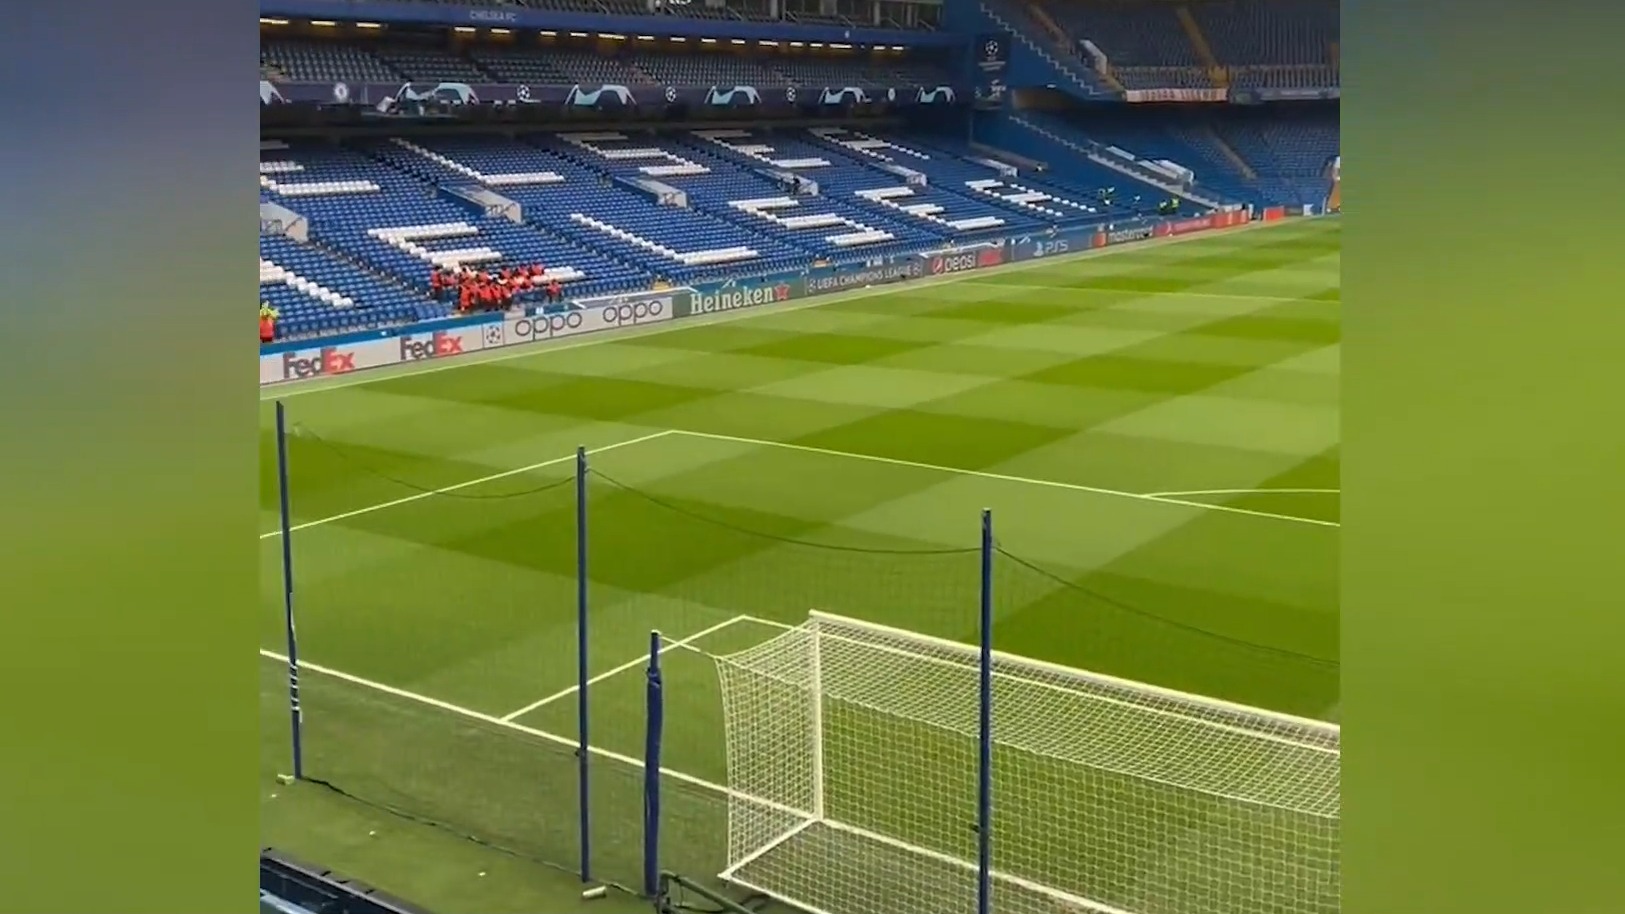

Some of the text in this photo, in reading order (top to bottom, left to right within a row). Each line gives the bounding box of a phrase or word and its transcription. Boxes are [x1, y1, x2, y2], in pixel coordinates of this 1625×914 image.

[817, 275, 839, 289] UEFA
[840, 269, 883, 286] CHAMPIONS
[690, 284, 773, 314] Heineken
[400, 331, 462, 359] FedEx
[283, 347, 355, 379] FedEx
